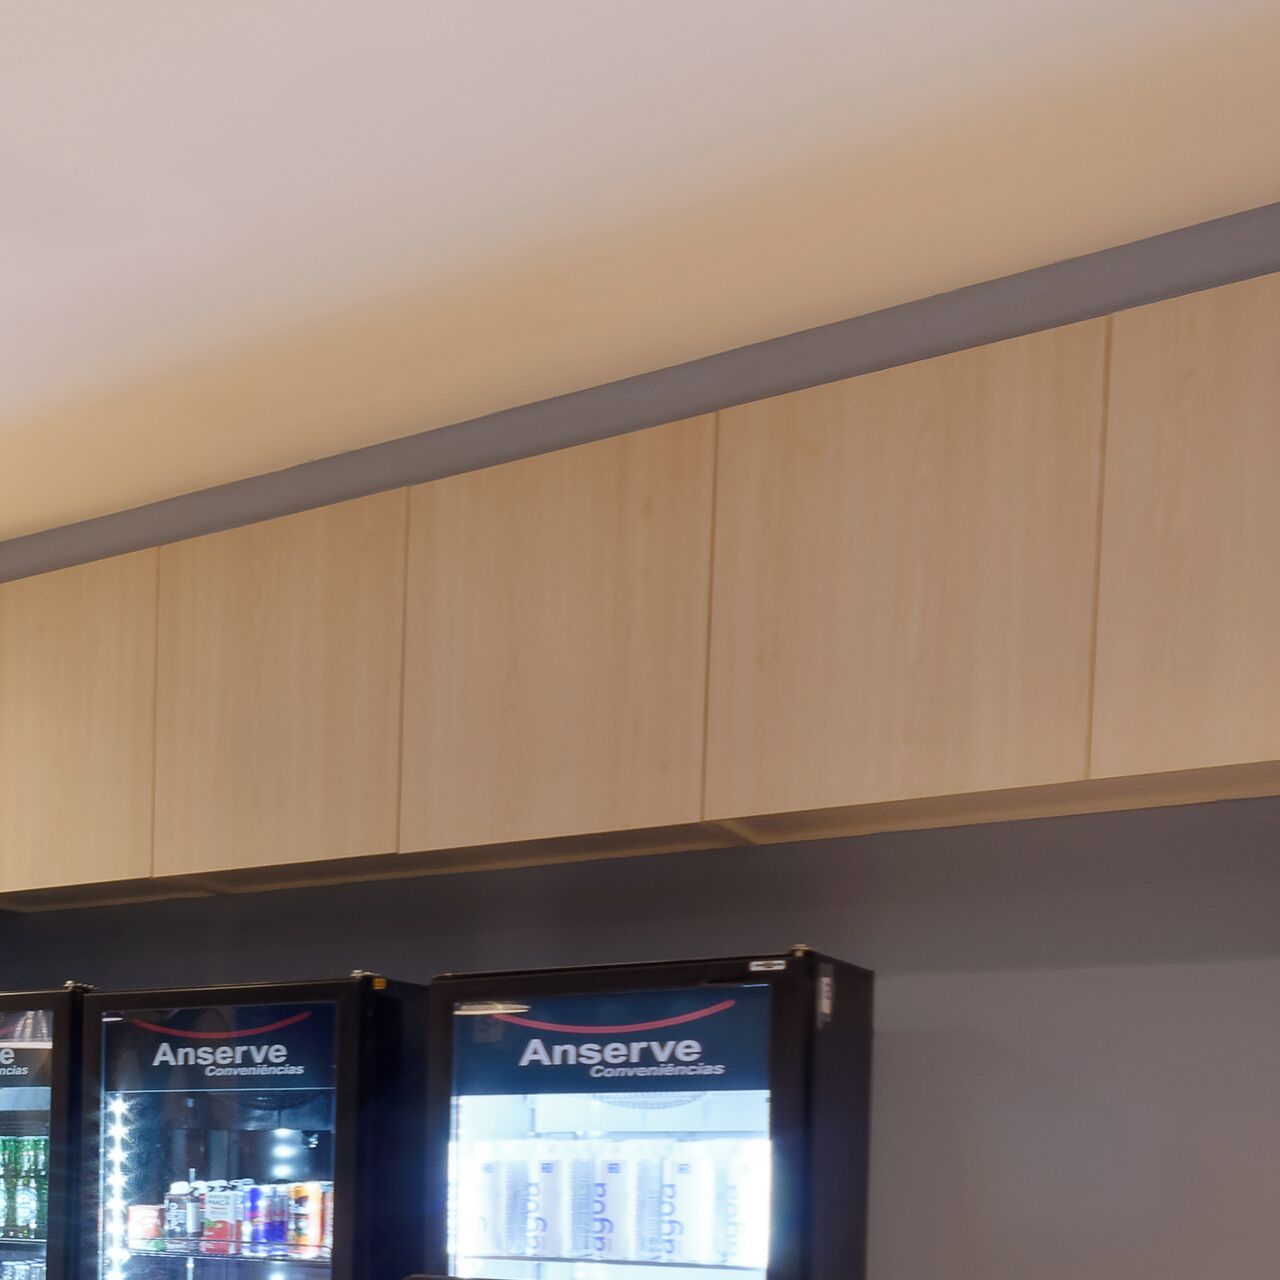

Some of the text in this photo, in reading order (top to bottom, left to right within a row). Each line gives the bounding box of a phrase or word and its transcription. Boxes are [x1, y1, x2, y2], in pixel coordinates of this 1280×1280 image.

[152, 1042, 288, 1066] Anserve
[518, 1038, 702, 1066] Anserve
[205, 1064, 305, 1077] Conveniências
[590, 1063, 726, 1078] Conveniências
